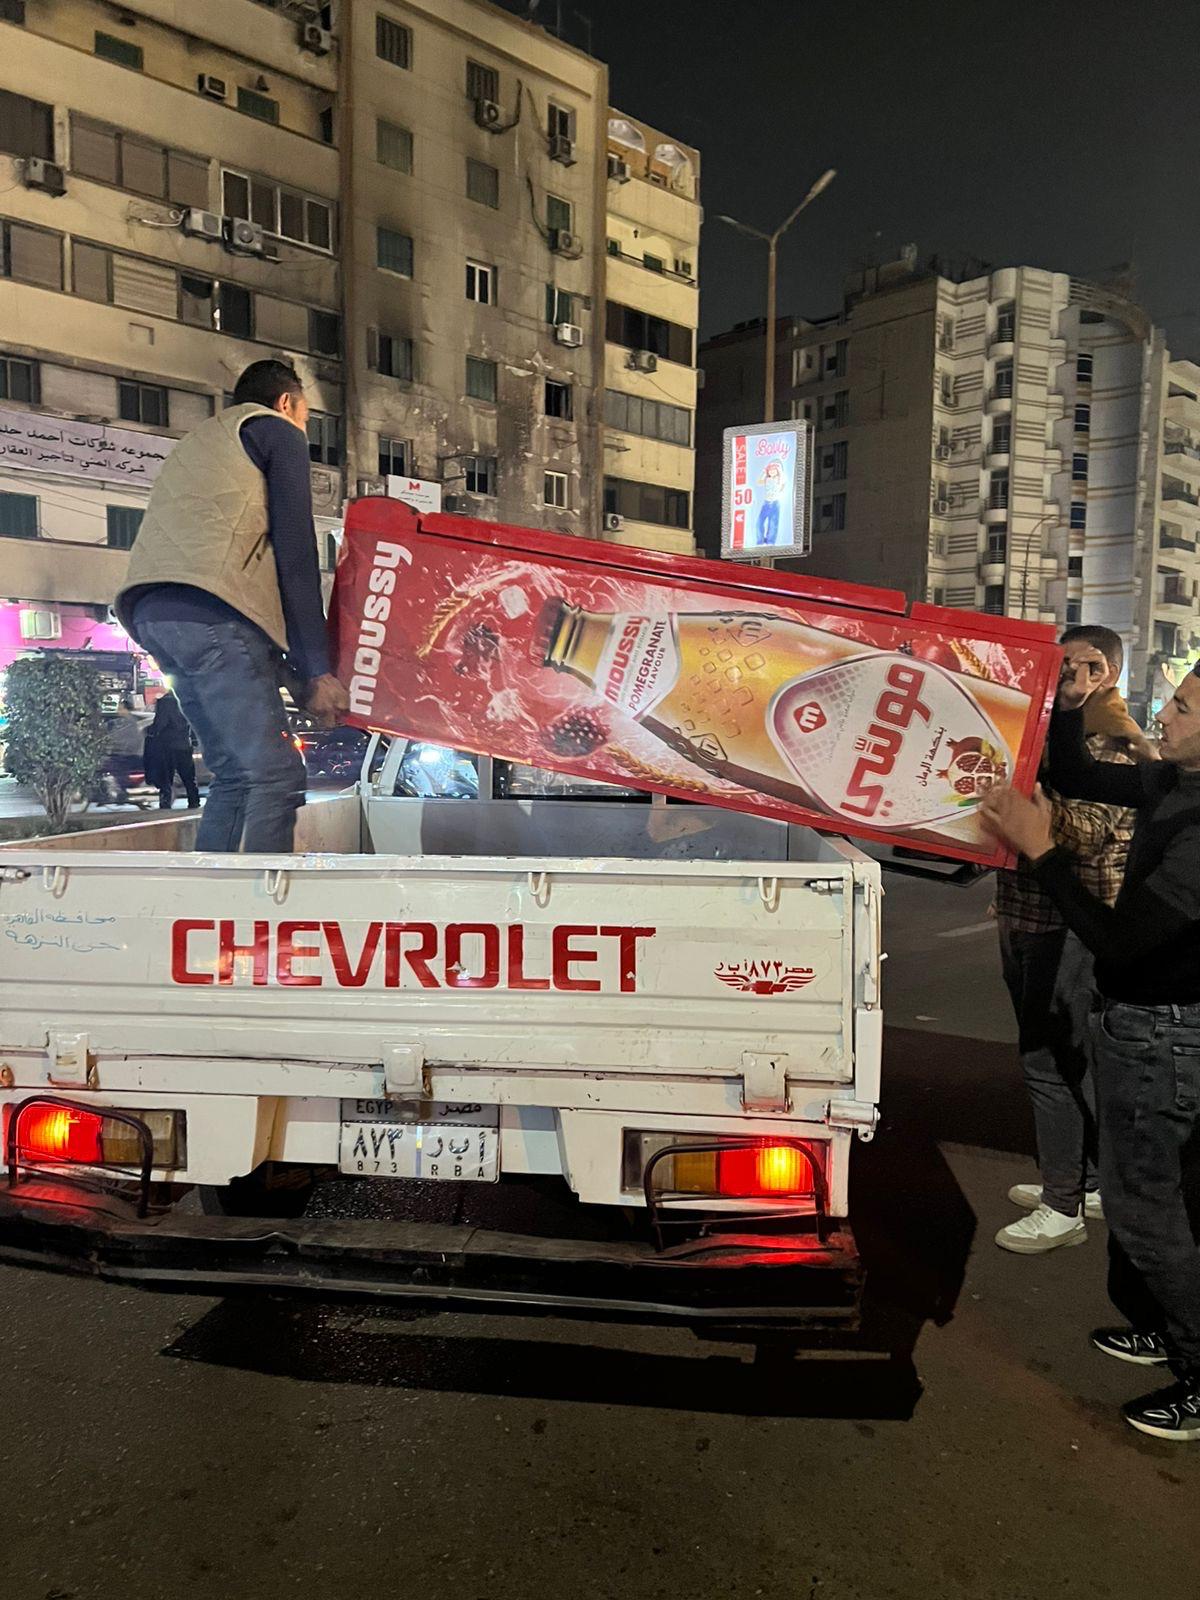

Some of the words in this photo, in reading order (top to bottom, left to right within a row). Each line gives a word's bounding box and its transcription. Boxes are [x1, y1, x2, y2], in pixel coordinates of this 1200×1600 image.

[734, 488, 753, 505] 50
[349, 540, 413, 716] moussy
[628, 620, 667, 711] POMEGRANATE
[647, 647, 666, 689] FLAVOUR
[931, 726, 948, 761] بنكهة
[915, 759, 933, 788] الرمان
[171, 918, 657, 993] CHEVROLET
[749, 960, 783, 978] ٨٧٣
[784, 966, 814, 974] مصر
[356, 1099, 394, 1114] EGYP
[439, 1102, 482, 1116] مصر
[353, 1128, 404, 1160] ٨٧٣
